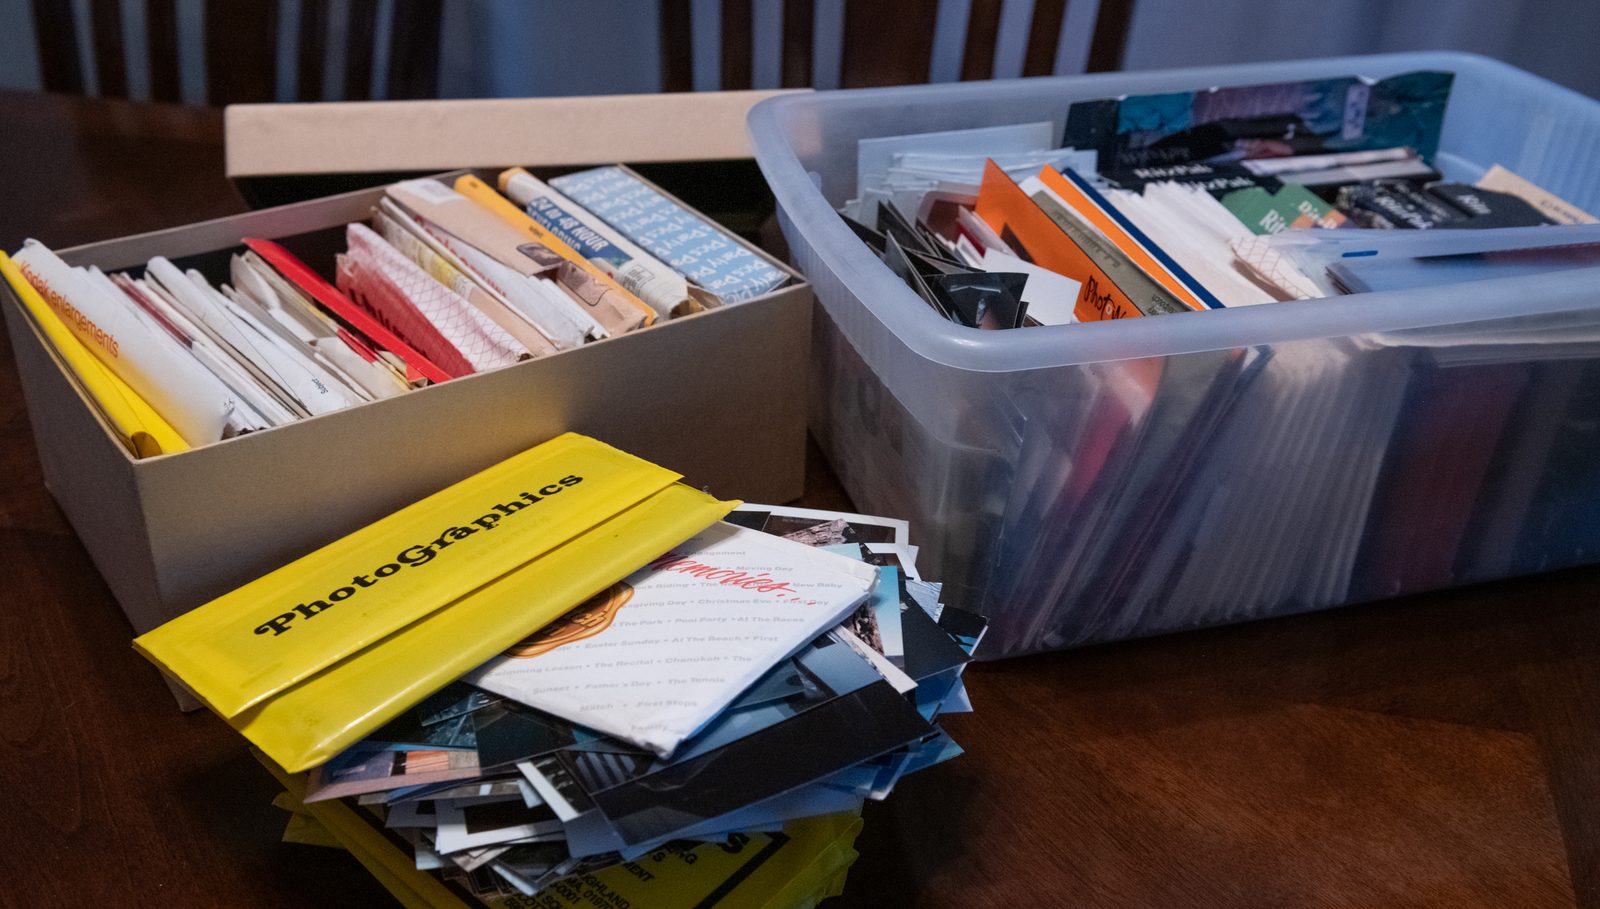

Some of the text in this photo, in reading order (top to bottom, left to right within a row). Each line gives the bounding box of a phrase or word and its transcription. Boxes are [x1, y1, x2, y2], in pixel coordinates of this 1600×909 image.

[571, 226, 609, 252] HOUR
[50, 291, 119, 358] enlargements
[253, 474, 584, 636] PhotoGraphics
[735, 565, 773, 573] Moving
[656, 581, 689, 590] Riding
[817, 581, 843, 589] Baby
[667, 600, 687, 608] Day
[698, 597, 750, 606] Christmas
[619, 620, 638, 628] The
[639, 619, 663, 627] Park
[701, 616, 728, 624] Party
[585, 641, 618, 650] Easter
[621, 639, 660, 648] Sunday
[545, 664, 583, 673] Lesson
[594, 659, 614, 669] The
[616, 657, 654, 667] Recital
[665, 656, 722, 664] Chanukah
[533, 684, 570, 695] Sunset
